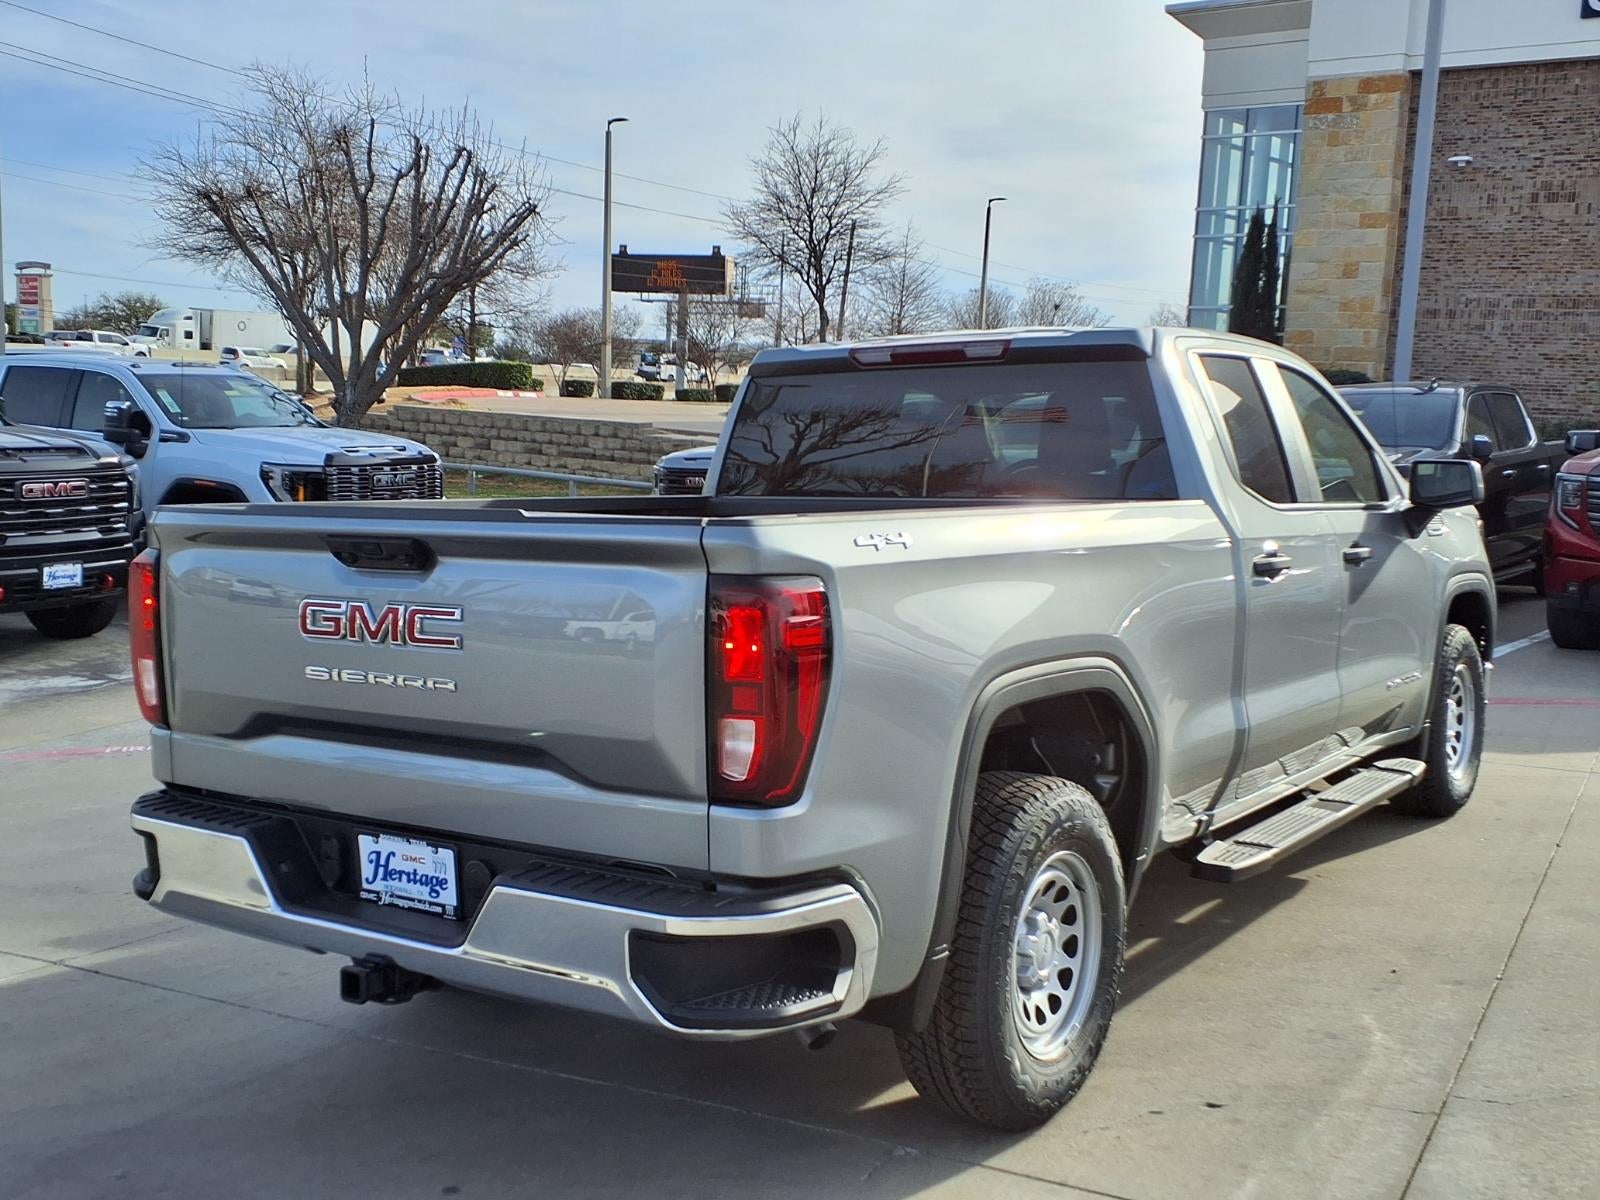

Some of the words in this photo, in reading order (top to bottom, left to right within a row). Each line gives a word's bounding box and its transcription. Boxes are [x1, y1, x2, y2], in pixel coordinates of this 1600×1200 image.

[22, 482, 87, 498] GMC
[373, 473, 417, 486] GMC
[299, 598, 464, 650] GMC
[304, 665, 458, 693] SIERRA
[401, 854, 427, 865] GMC
[365, 850, 450, 899] Heritage
